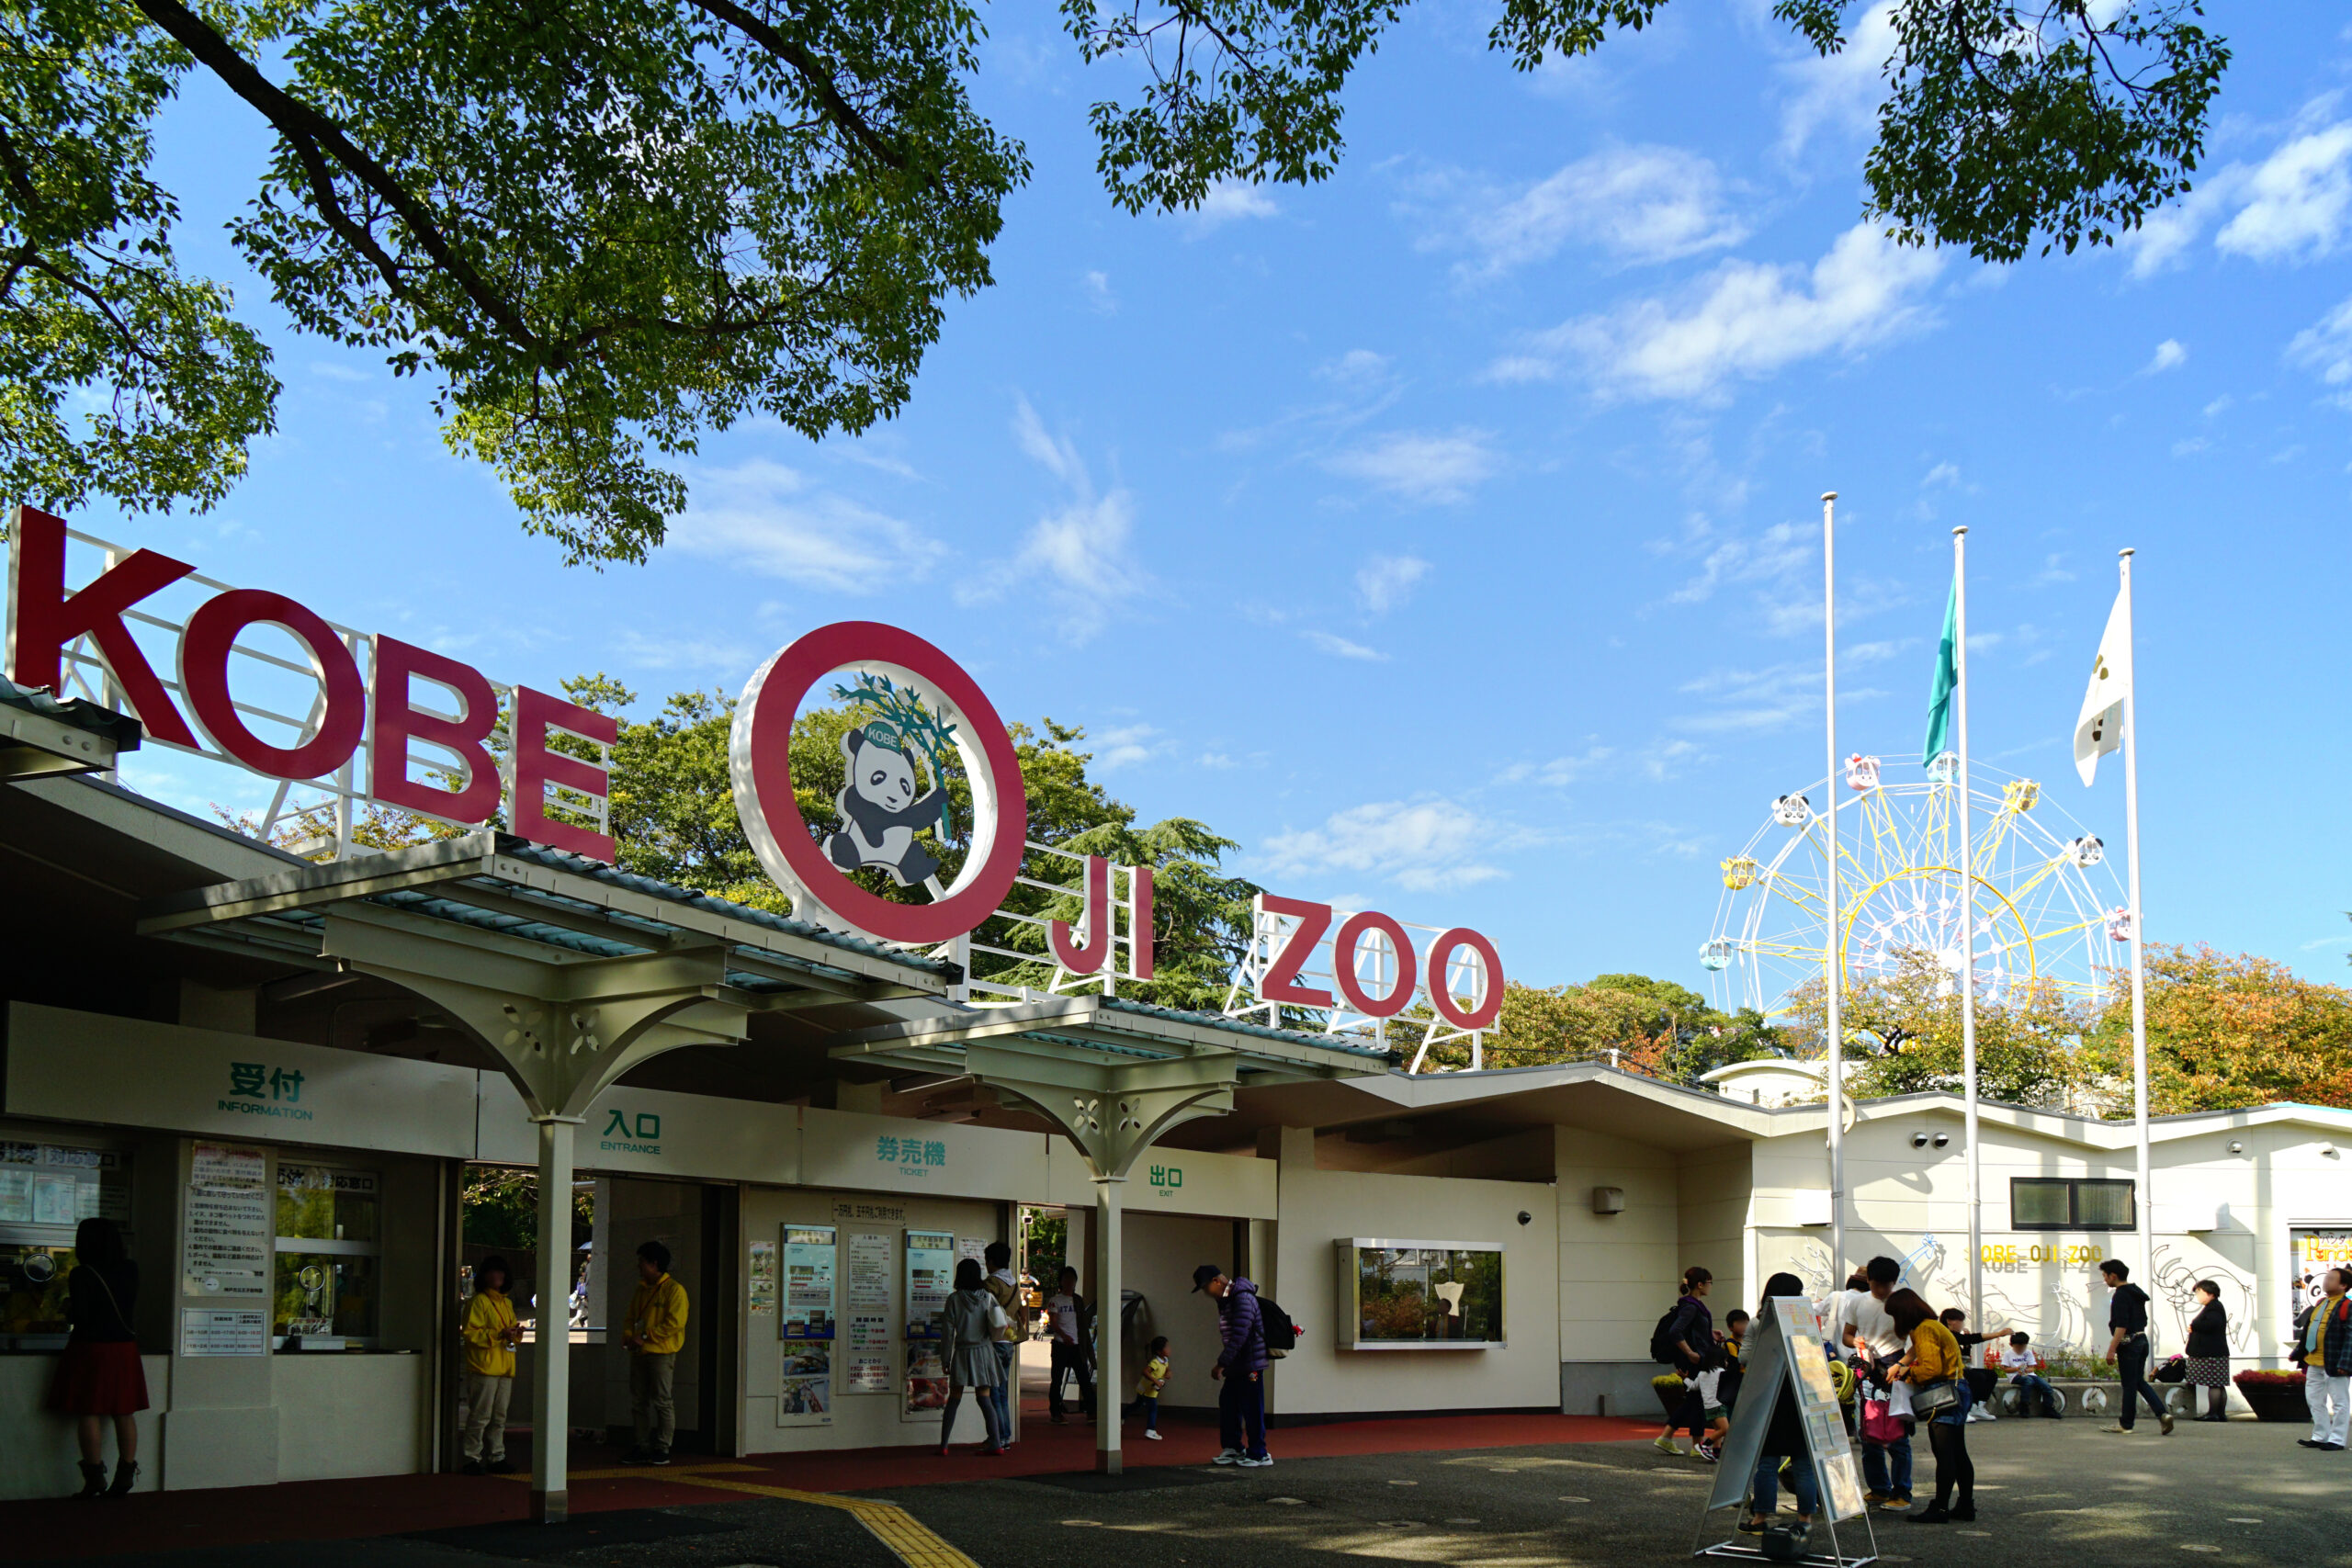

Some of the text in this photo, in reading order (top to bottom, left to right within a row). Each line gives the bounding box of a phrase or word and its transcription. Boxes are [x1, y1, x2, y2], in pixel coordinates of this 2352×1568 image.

[868, 728, 898, 748] KOBE
[11, 505, 617, 864] KOBE
[1254, 894, 1504, 1030] ZOO
[229, 1062, 304, 1102] 受付
[218, 1100, 313, 1121] INFORMATION
[604, 1110, 660, 1139] 入口
[50, 1149, 115, 1167] 対応窓口
[601, 1141, 662, 1155] ENTRANCE
[876, 1135, 945, 1166] 券売機
[899, 1167, 929, 1177] TICKET
[1150, 1165, 1182, 1188] 出口
[1967, 1245, 2102, 1263] OBE OJI ZOO
